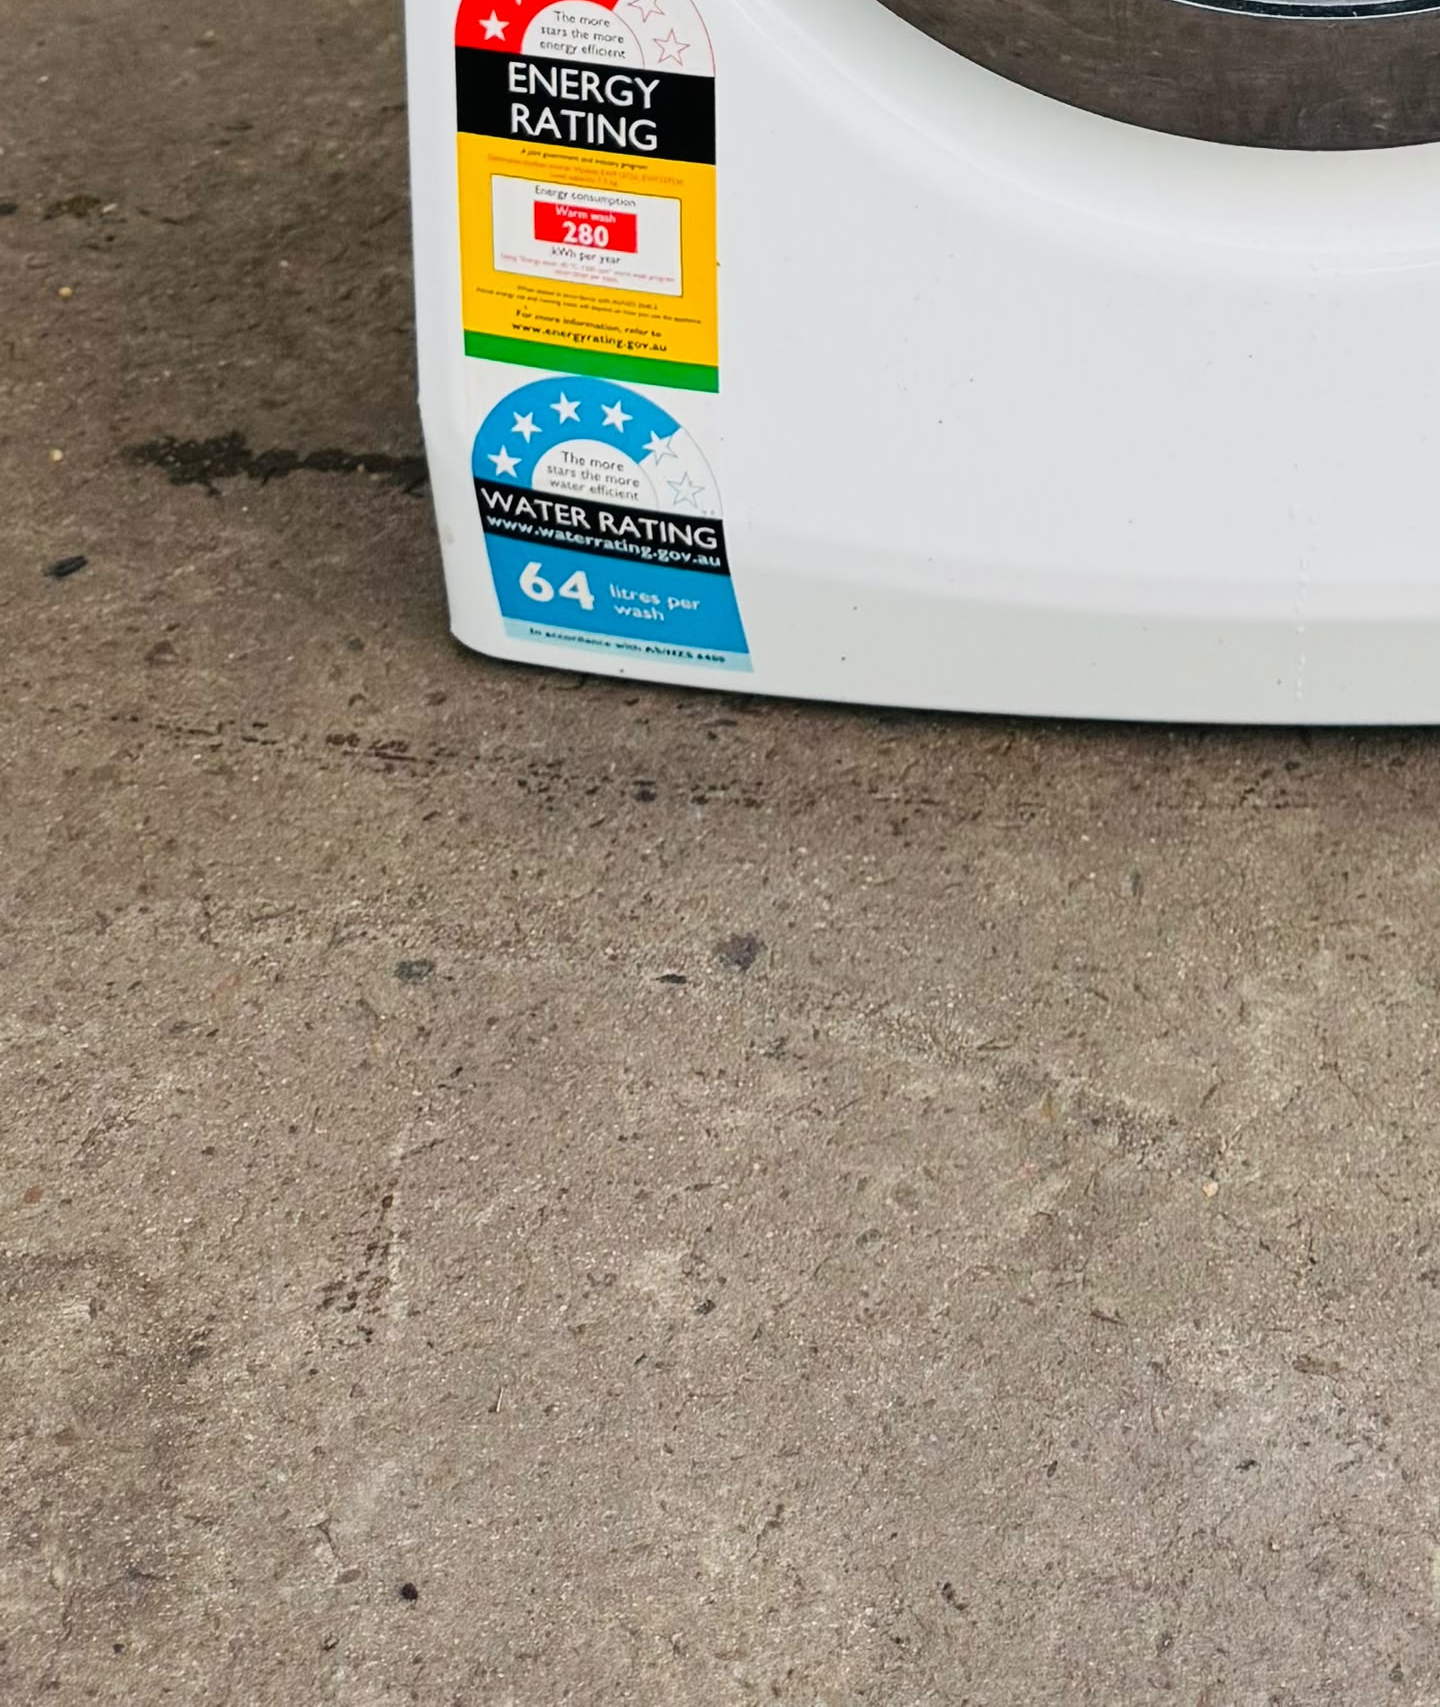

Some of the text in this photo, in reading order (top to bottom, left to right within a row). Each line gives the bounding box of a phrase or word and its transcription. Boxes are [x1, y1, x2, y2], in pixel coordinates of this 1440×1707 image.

[554, 10, 610, 27] The more
[541, 27, 624, 43] stars the more
[540, 41, 625, 59] energy efficient
[508, 61, 660, 110] ENERGY
[510, 103, 658, 151] RATING
[535, 185, 636, 207] Energy consumption
[556, 204, 616, 223] Warm wash
[562, 221, 609, 247] 280
[551, 246, 576, 259] kWh
[580, 249, 596, 262] per
[599, 253, 620, 265] year
[535, 313, 560, 324] more
[512, 322, 667, 352] www.energyrating.gov.au
[561, 451, 624, 472] The more
[547, 465, 639, 488] stars the more
[550, 479, 638, 501] water efficient
[481, 488, 717, 550] WATER RATING
[486, 515, 721, 567] www.waterrating.gov.au
[519, 561, 595, 611] 64
[610, 584, 701, 610] litres per
[614, 605, 664, 622] wash
